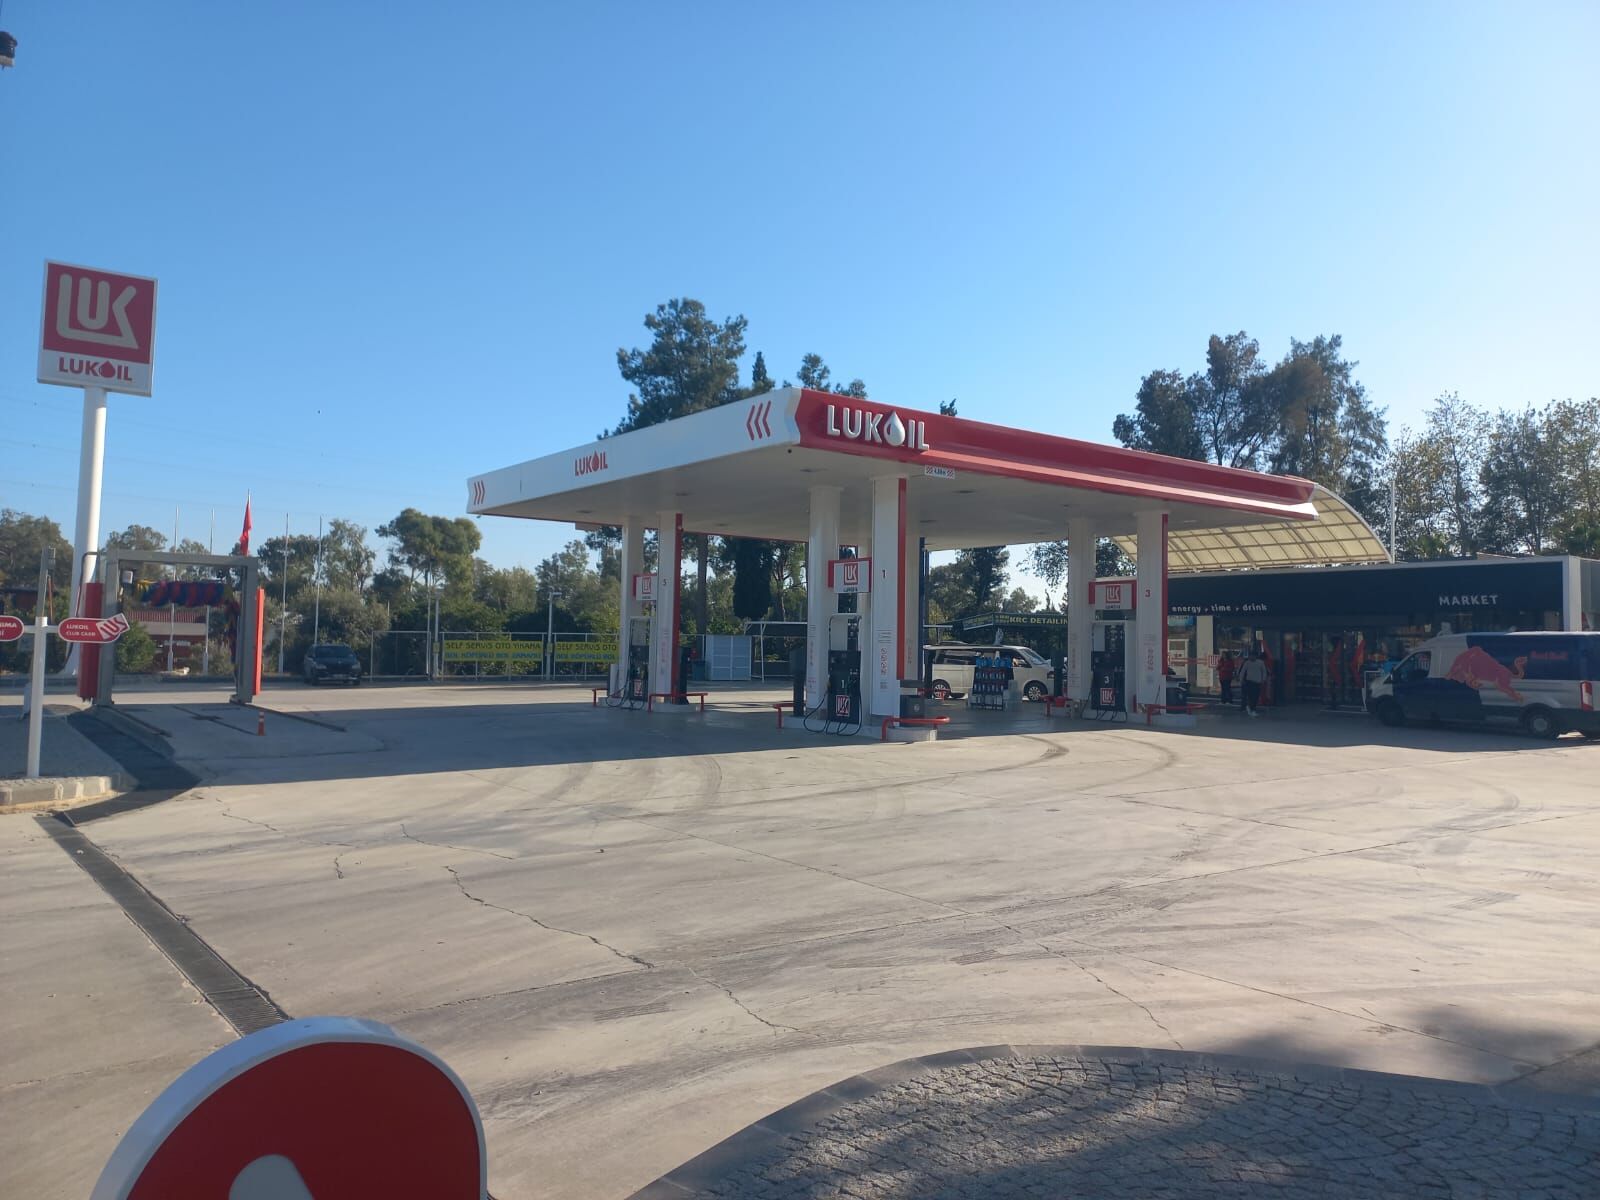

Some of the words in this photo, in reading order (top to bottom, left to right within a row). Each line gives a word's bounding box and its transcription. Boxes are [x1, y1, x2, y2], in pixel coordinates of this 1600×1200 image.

[56, 273, 139, 350] LUK
[58, 356, 133, 382] LUKOIL
[826, 404, 930, 451] LUKOIL
[575, 450, 609, 477] LUKOIL
[882, 569, 887, 578] 1
[1144, 588, 1151, 598] 3
[1439, 594, 1499, 606] MARKET
[1171, 605, 1201, 614] energy
[1211, 603, 1231, 612] time
[1242, 602, 1268, 612] drink
[1009, 617, 1028, 625] KRC
[1030, 617, 1068, 625] DETAILIN
[1104, 676, 1110, 685] 3
